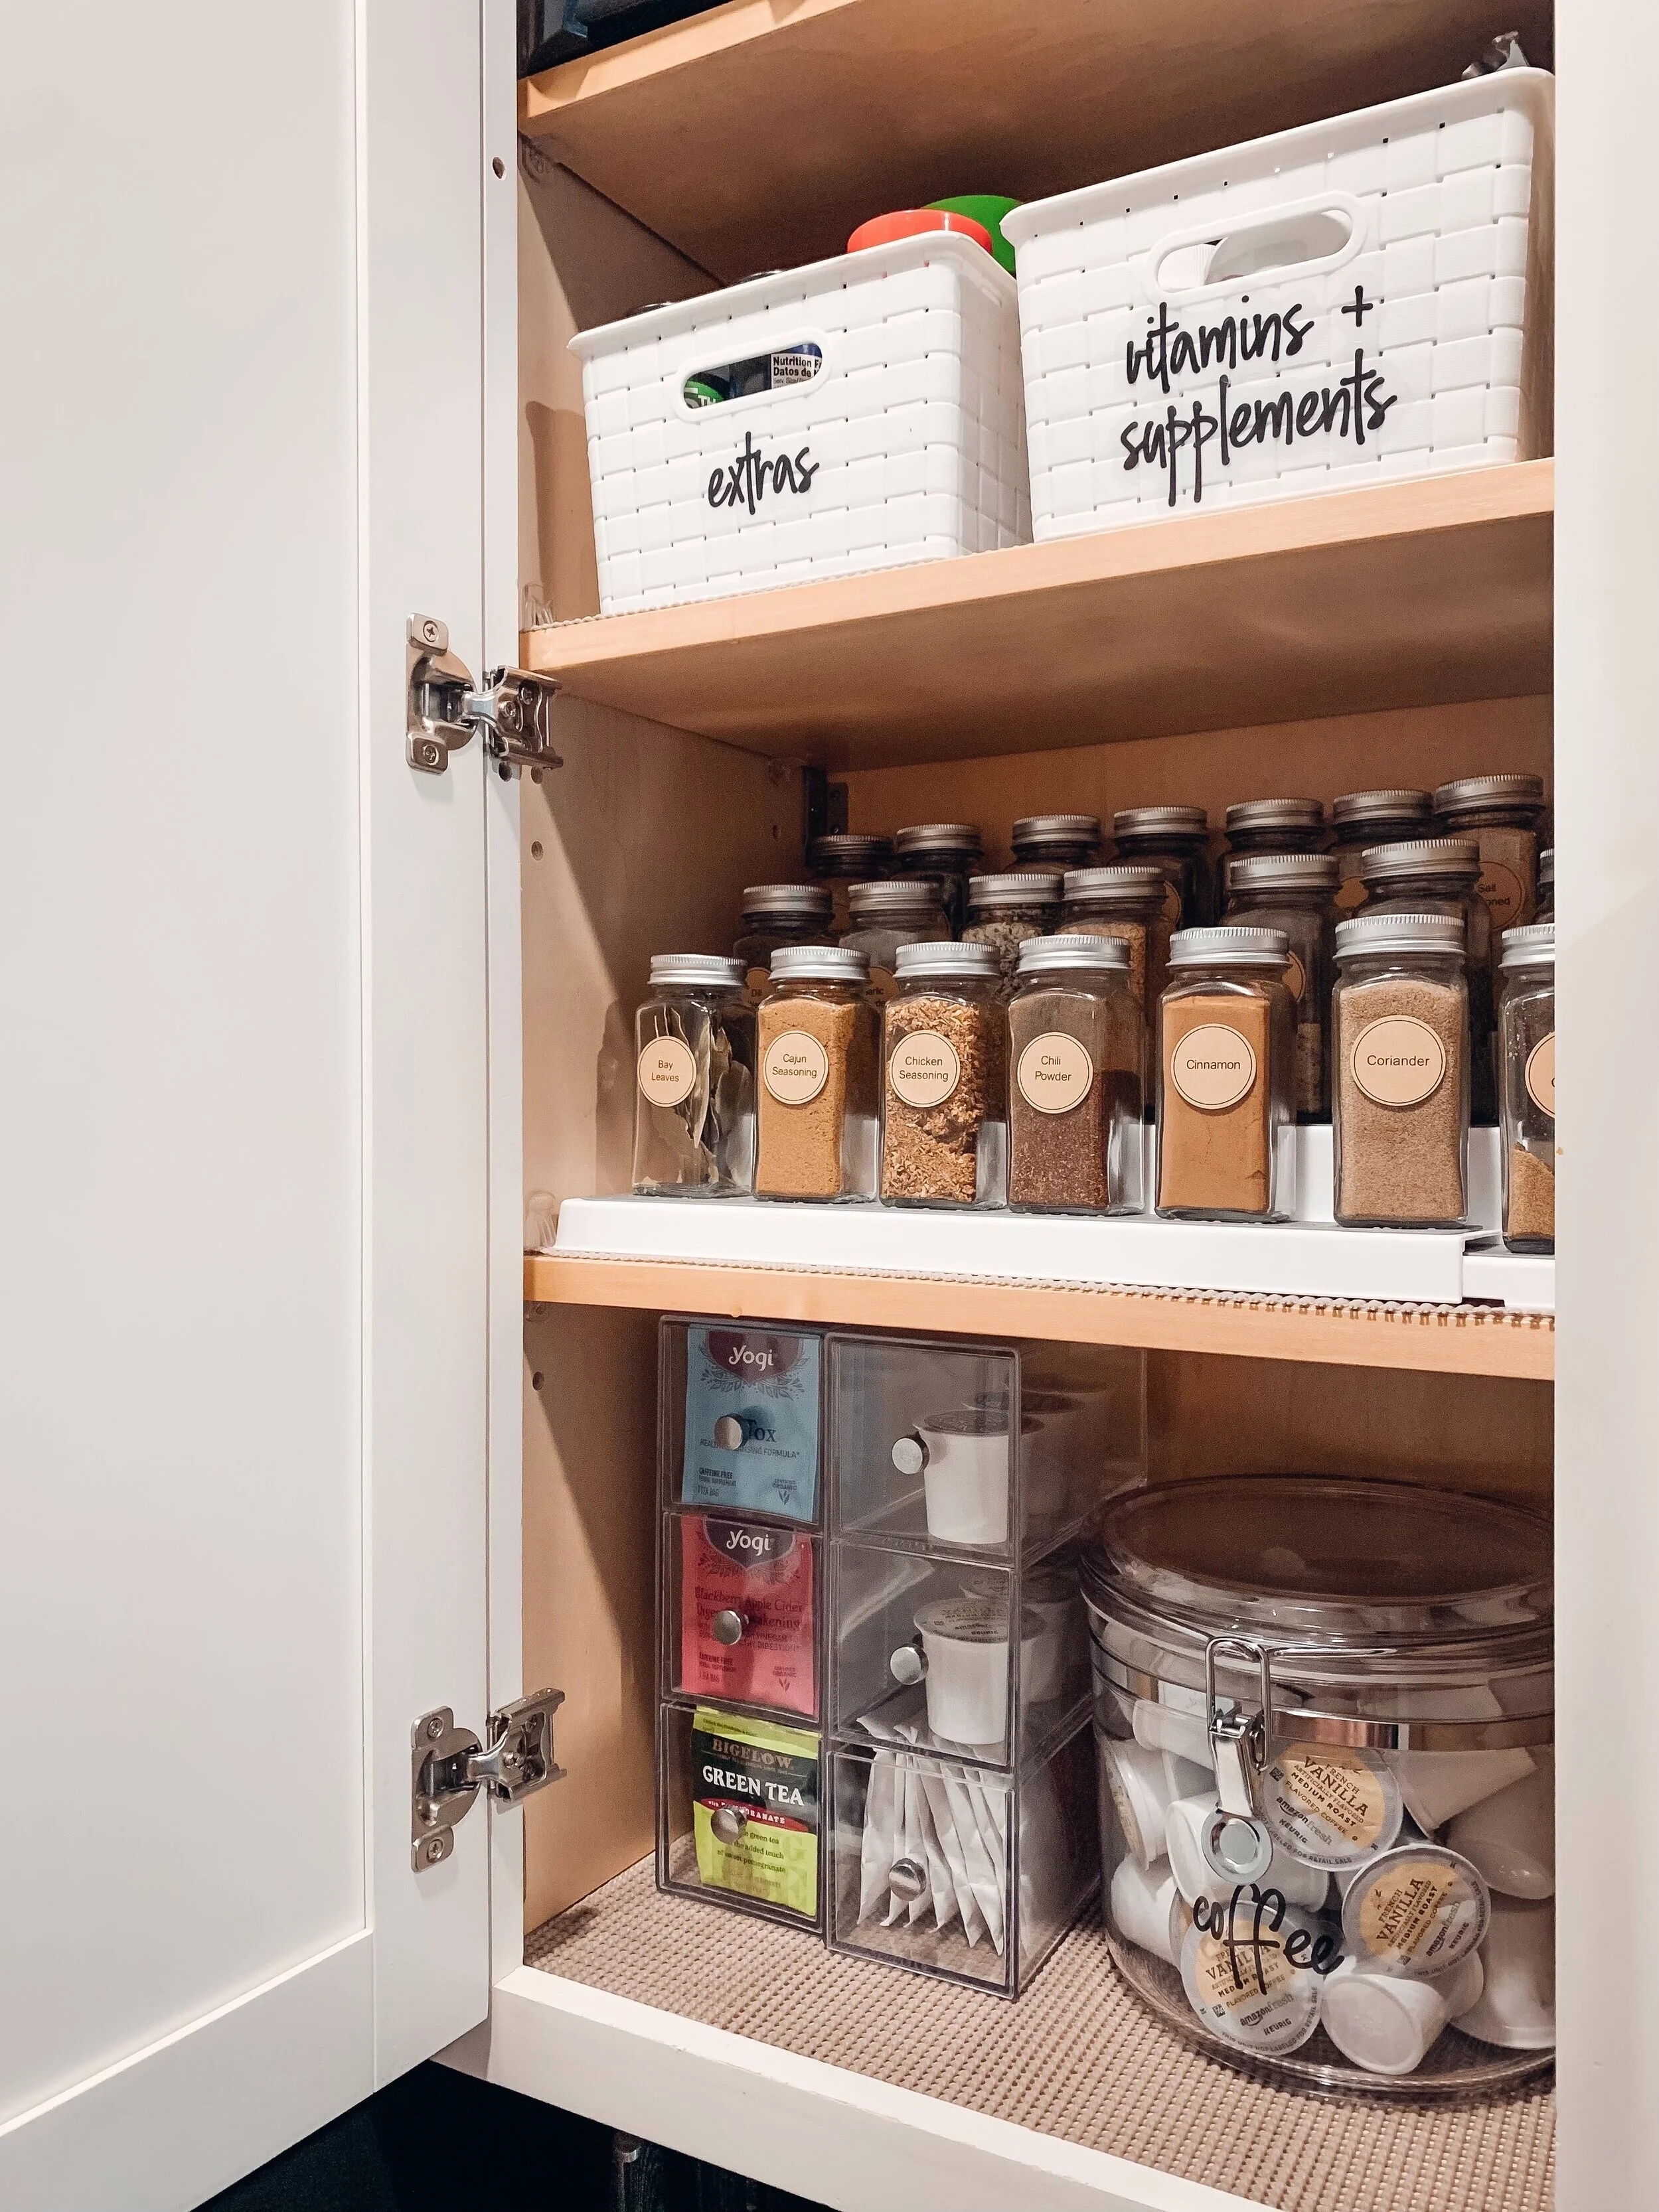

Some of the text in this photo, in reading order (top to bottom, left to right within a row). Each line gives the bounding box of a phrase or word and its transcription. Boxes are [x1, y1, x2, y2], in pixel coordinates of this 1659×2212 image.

[1127, 285, 1373, 394] vitamins +
[773, 355, 812, 368] Nutrition
[773, 366, 799, 376] Datos
[801, 367, 811, 377] de
[1121, 348, 1397, 506] supplements
[708, 431, 820, 515] extras
[865, 986, 885, 996] arlic
[658, 1060, 673, 1071] Bay
[772, 1067, 817, 1079] Seasoning
[783, 1053, 807, 1065] Cajun
[905, 1056, 943, 1066] Chicken
[1041, 1055, 1062, 1066] Chili
[1186, 1059, 1241, 1070] Cinnamon
[1366, 1054, 1431, 1067] Coriander
[651, 1072, 680, 1082] Leaves
[899, 1070, 949, 1082] Seasoning
[1034, 1071, 1072, 1082] Powder
[712, 1737, 793, 1769] BIGELOW
[702, 1765, 805, 1806] GREEN TEA
[1304, 1755, 1369, 1817] VANILLA
[1325, 1763, 1360, 1795] FRENCH
[1291, 1771, 1356, 1827] MEDIUM ROAST
[1294, 1763, 1364, 1824] ARTIFICIALLY FLAVORED
[1285, 1781, 1349, 1835] FLAVORED COFFEE
[750, 1832, 767, 1843] green
[769, 1836, 779, 1845] tea
[1279, 1818, 1308, 1844] KEURIG
[734, 1840, 784, 1859] the added touch
[744, 1857, 786, 1874] pomegranate
[1376, 1878, 1424, 1939] VANILLA
[1378, 1888, 1403, 1923] FRENCH
[1395, 1885, 1438, 1949] MEDIUM ROAST
[1407, 1891, 1448, 1953] FLAVORED COFFEE
[1448, 1921, 1470, 1949] KEURIG
[1193, 1883, 1346, 1996] coffee
[1206, 1947, 1271, 1980] VANILA
[1218, 1962, 1279, 1998] MEDM RAST
[1226, 1974, 1286, 2008] FLAVORED OFFEE
[1263, 2018, 1292, 2036] KEURIG
